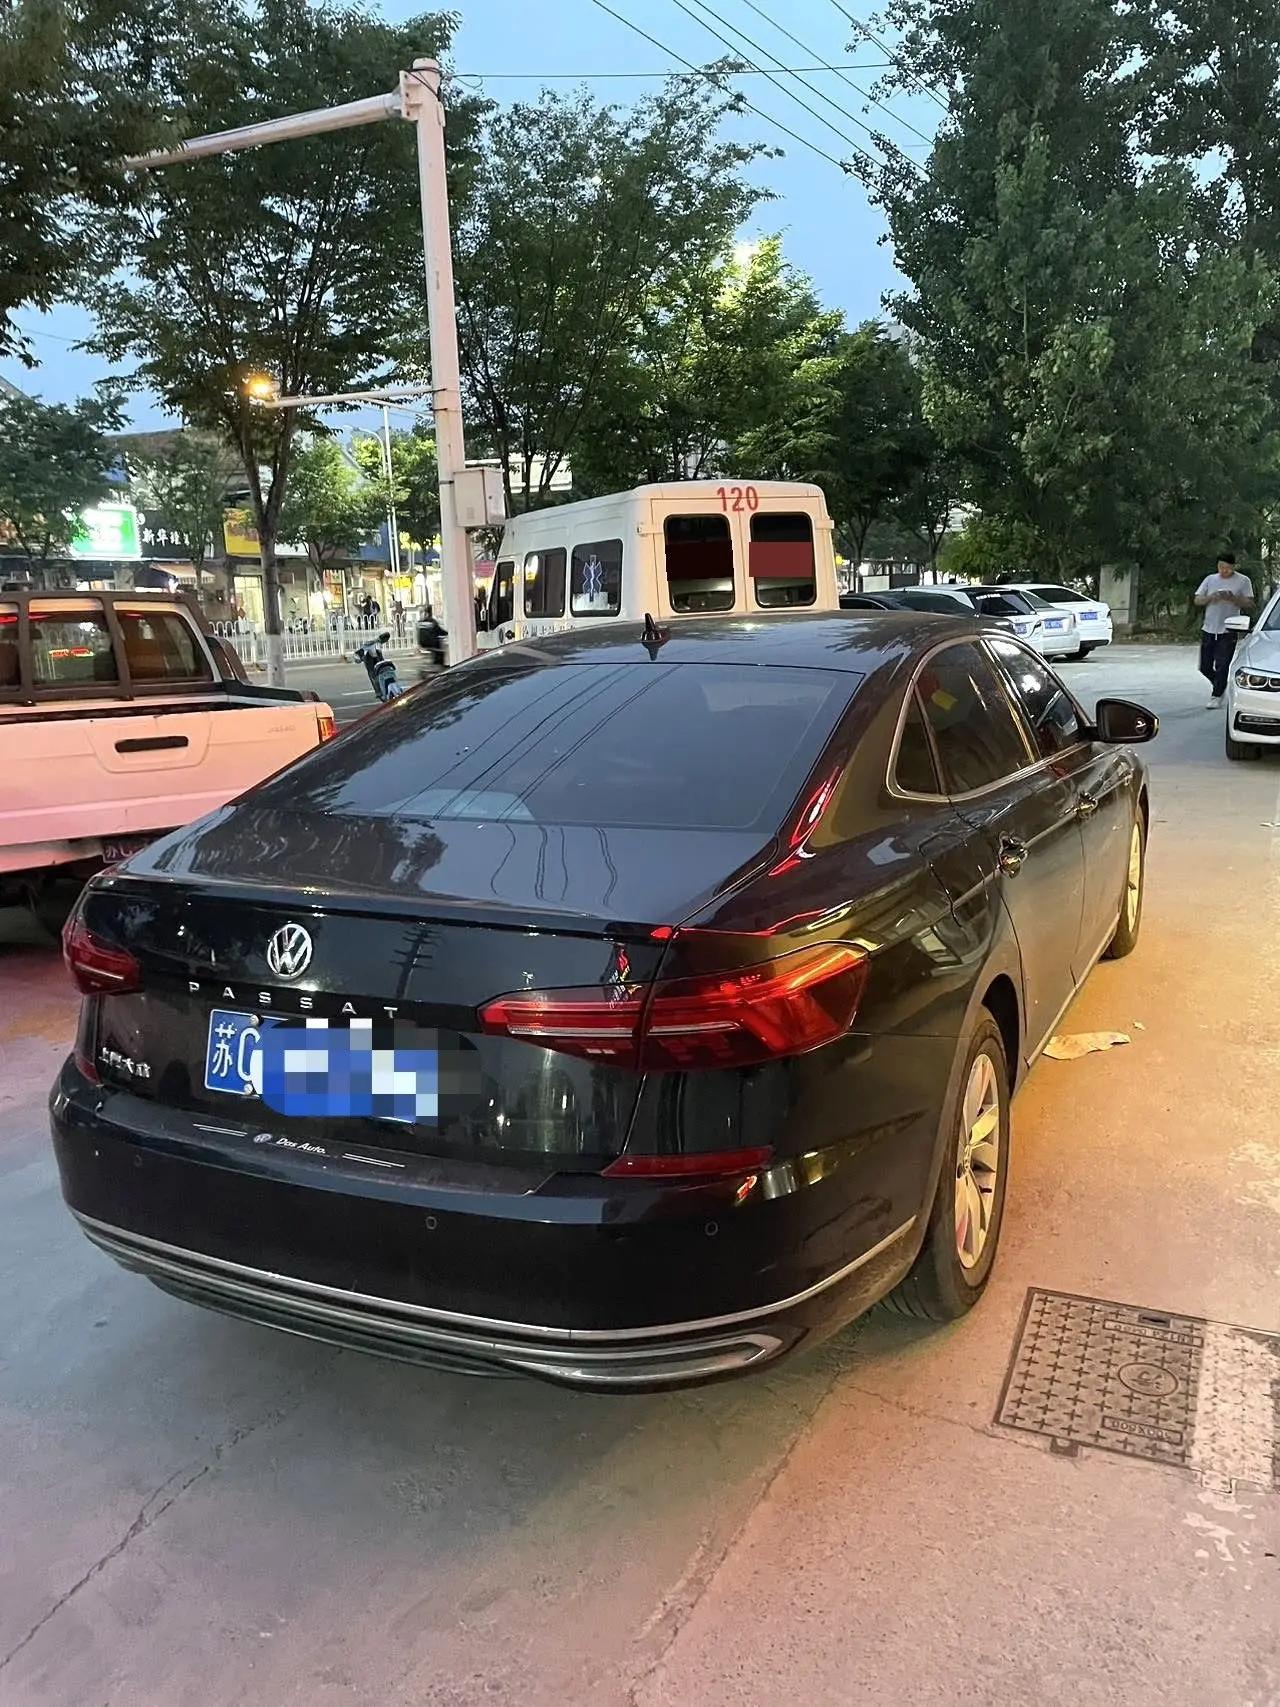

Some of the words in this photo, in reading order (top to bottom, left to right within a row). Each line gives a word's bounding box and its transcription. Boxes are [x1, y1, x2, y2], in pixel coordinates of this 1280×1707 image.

[717, 486, 758, 511] 120
[188, 981, 398, 1019] PASSAT
[276, 1137, 298, 1148] Das
